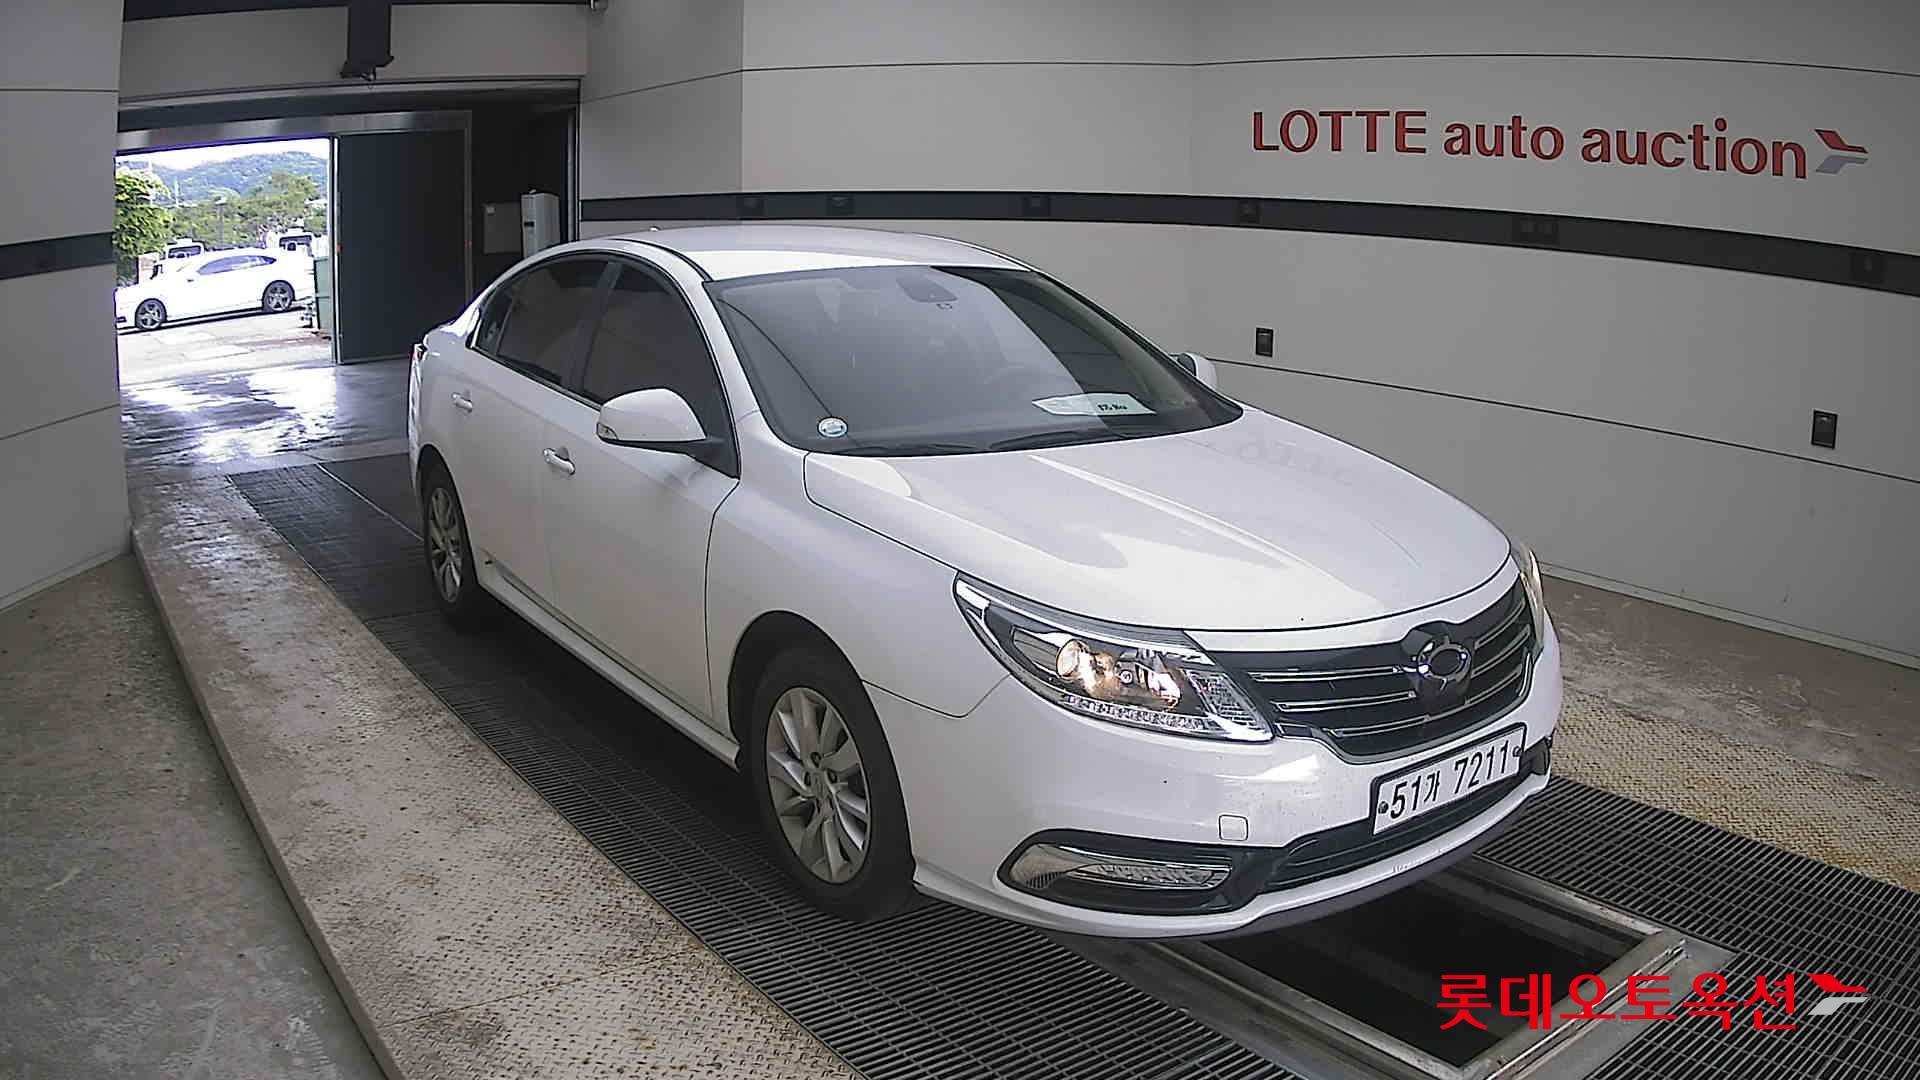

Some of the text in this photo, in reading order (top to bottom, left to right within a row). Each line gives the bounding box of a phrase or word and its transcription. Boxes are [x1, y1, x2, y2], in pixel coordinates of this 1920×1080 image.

[1252, 110, 1808, 179] LOTTE auto auction
[1390, 739, 1509, 819] 51가 7211
